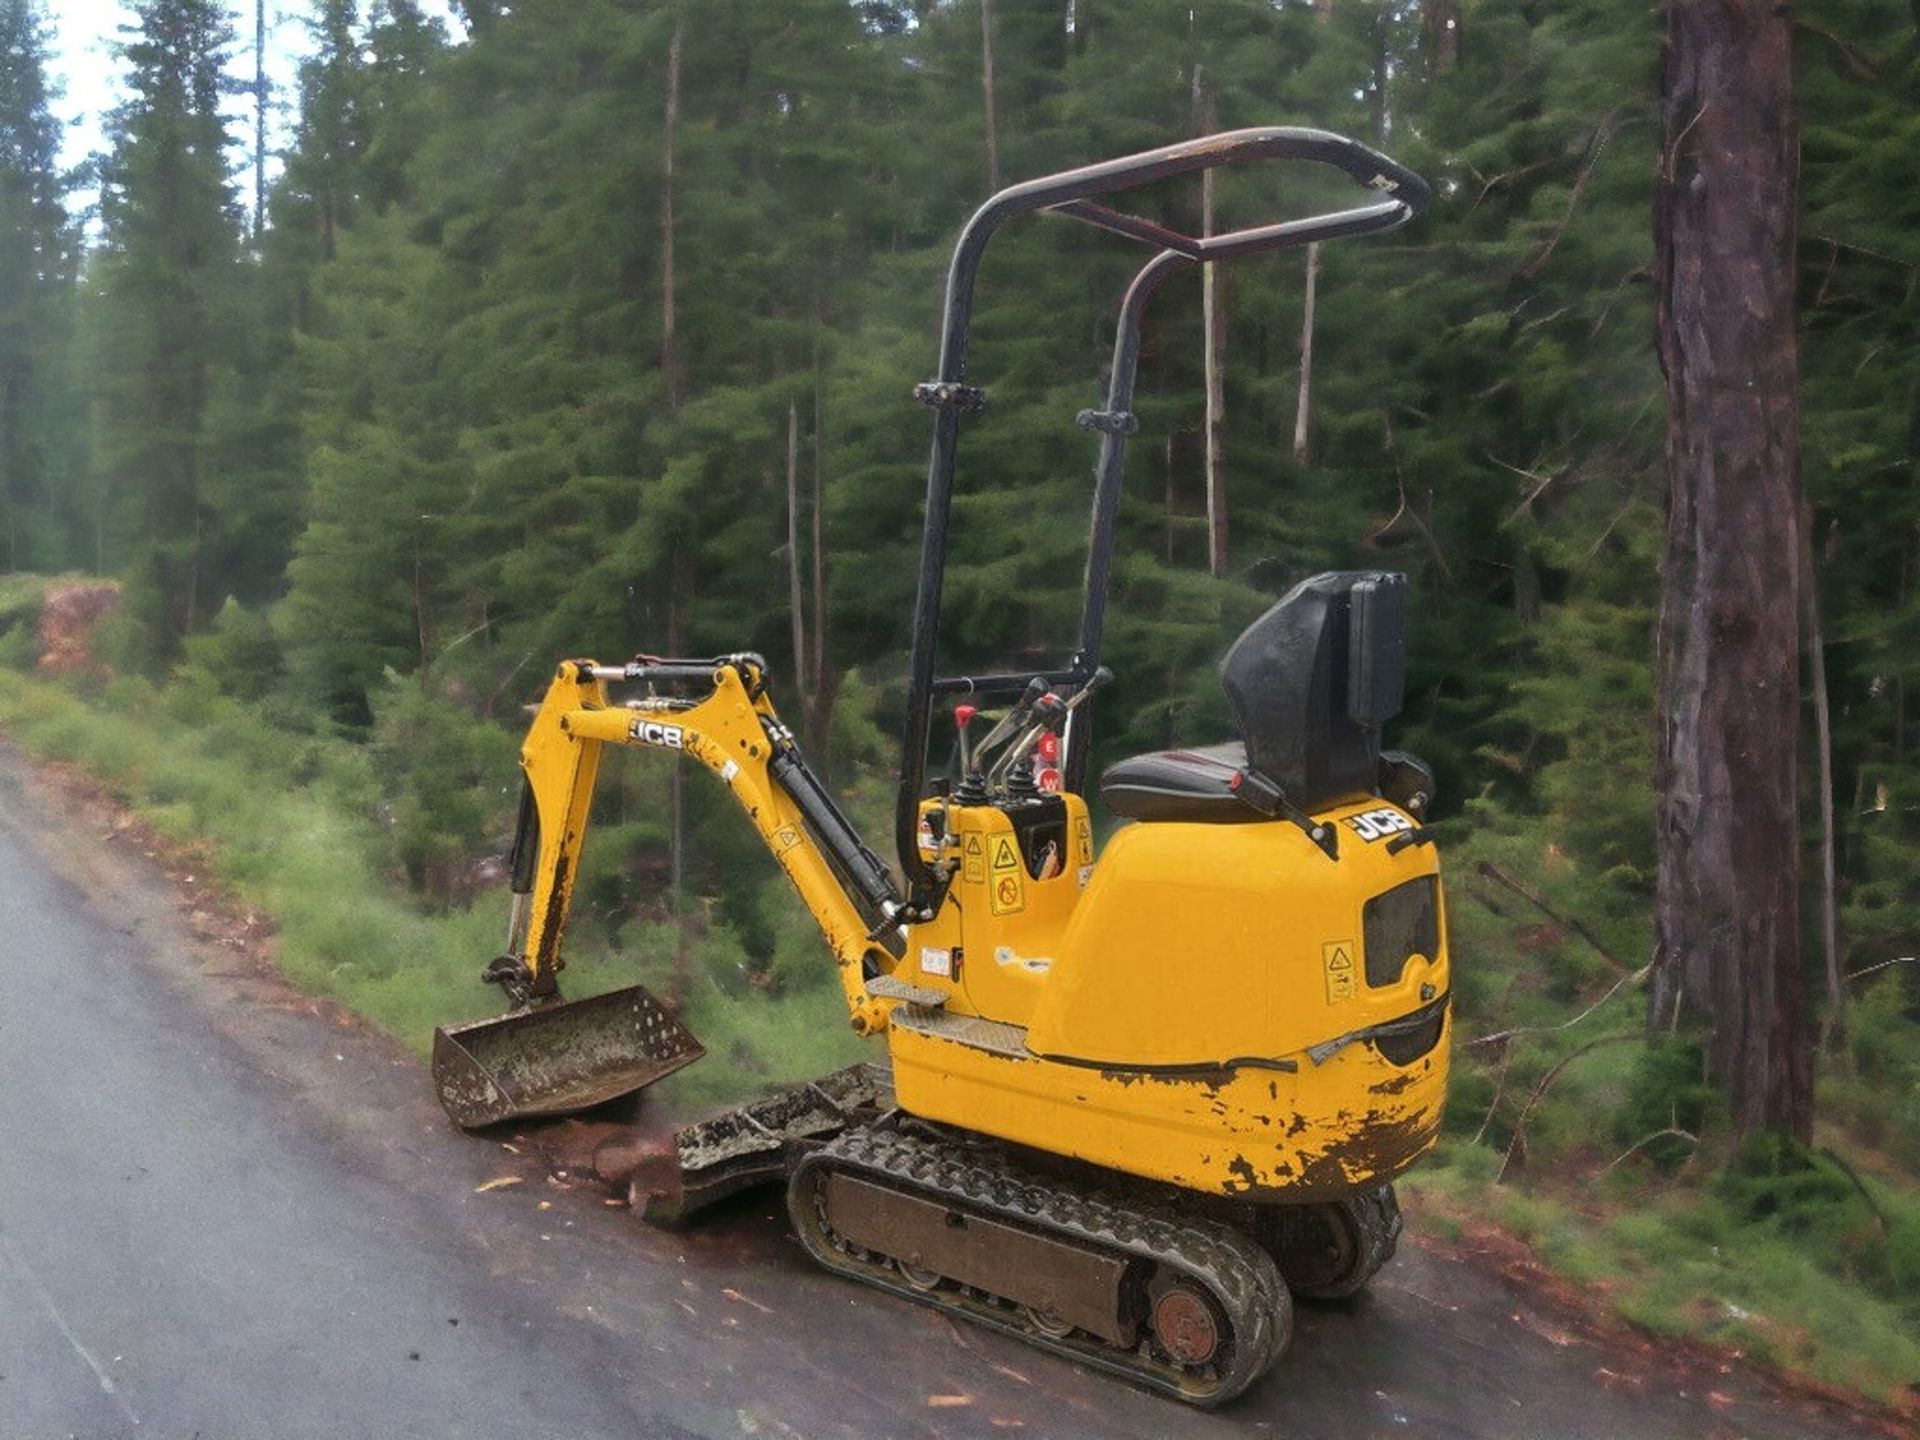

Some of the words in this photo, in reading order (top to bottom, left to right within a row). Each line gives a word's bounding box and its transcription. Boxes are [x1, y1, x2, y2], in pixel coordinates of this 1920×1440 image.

[629, 718, 683, 749] JCB
[1045, 741, 1053, 753] E
[1350, 808, 1414, 841] JCB
